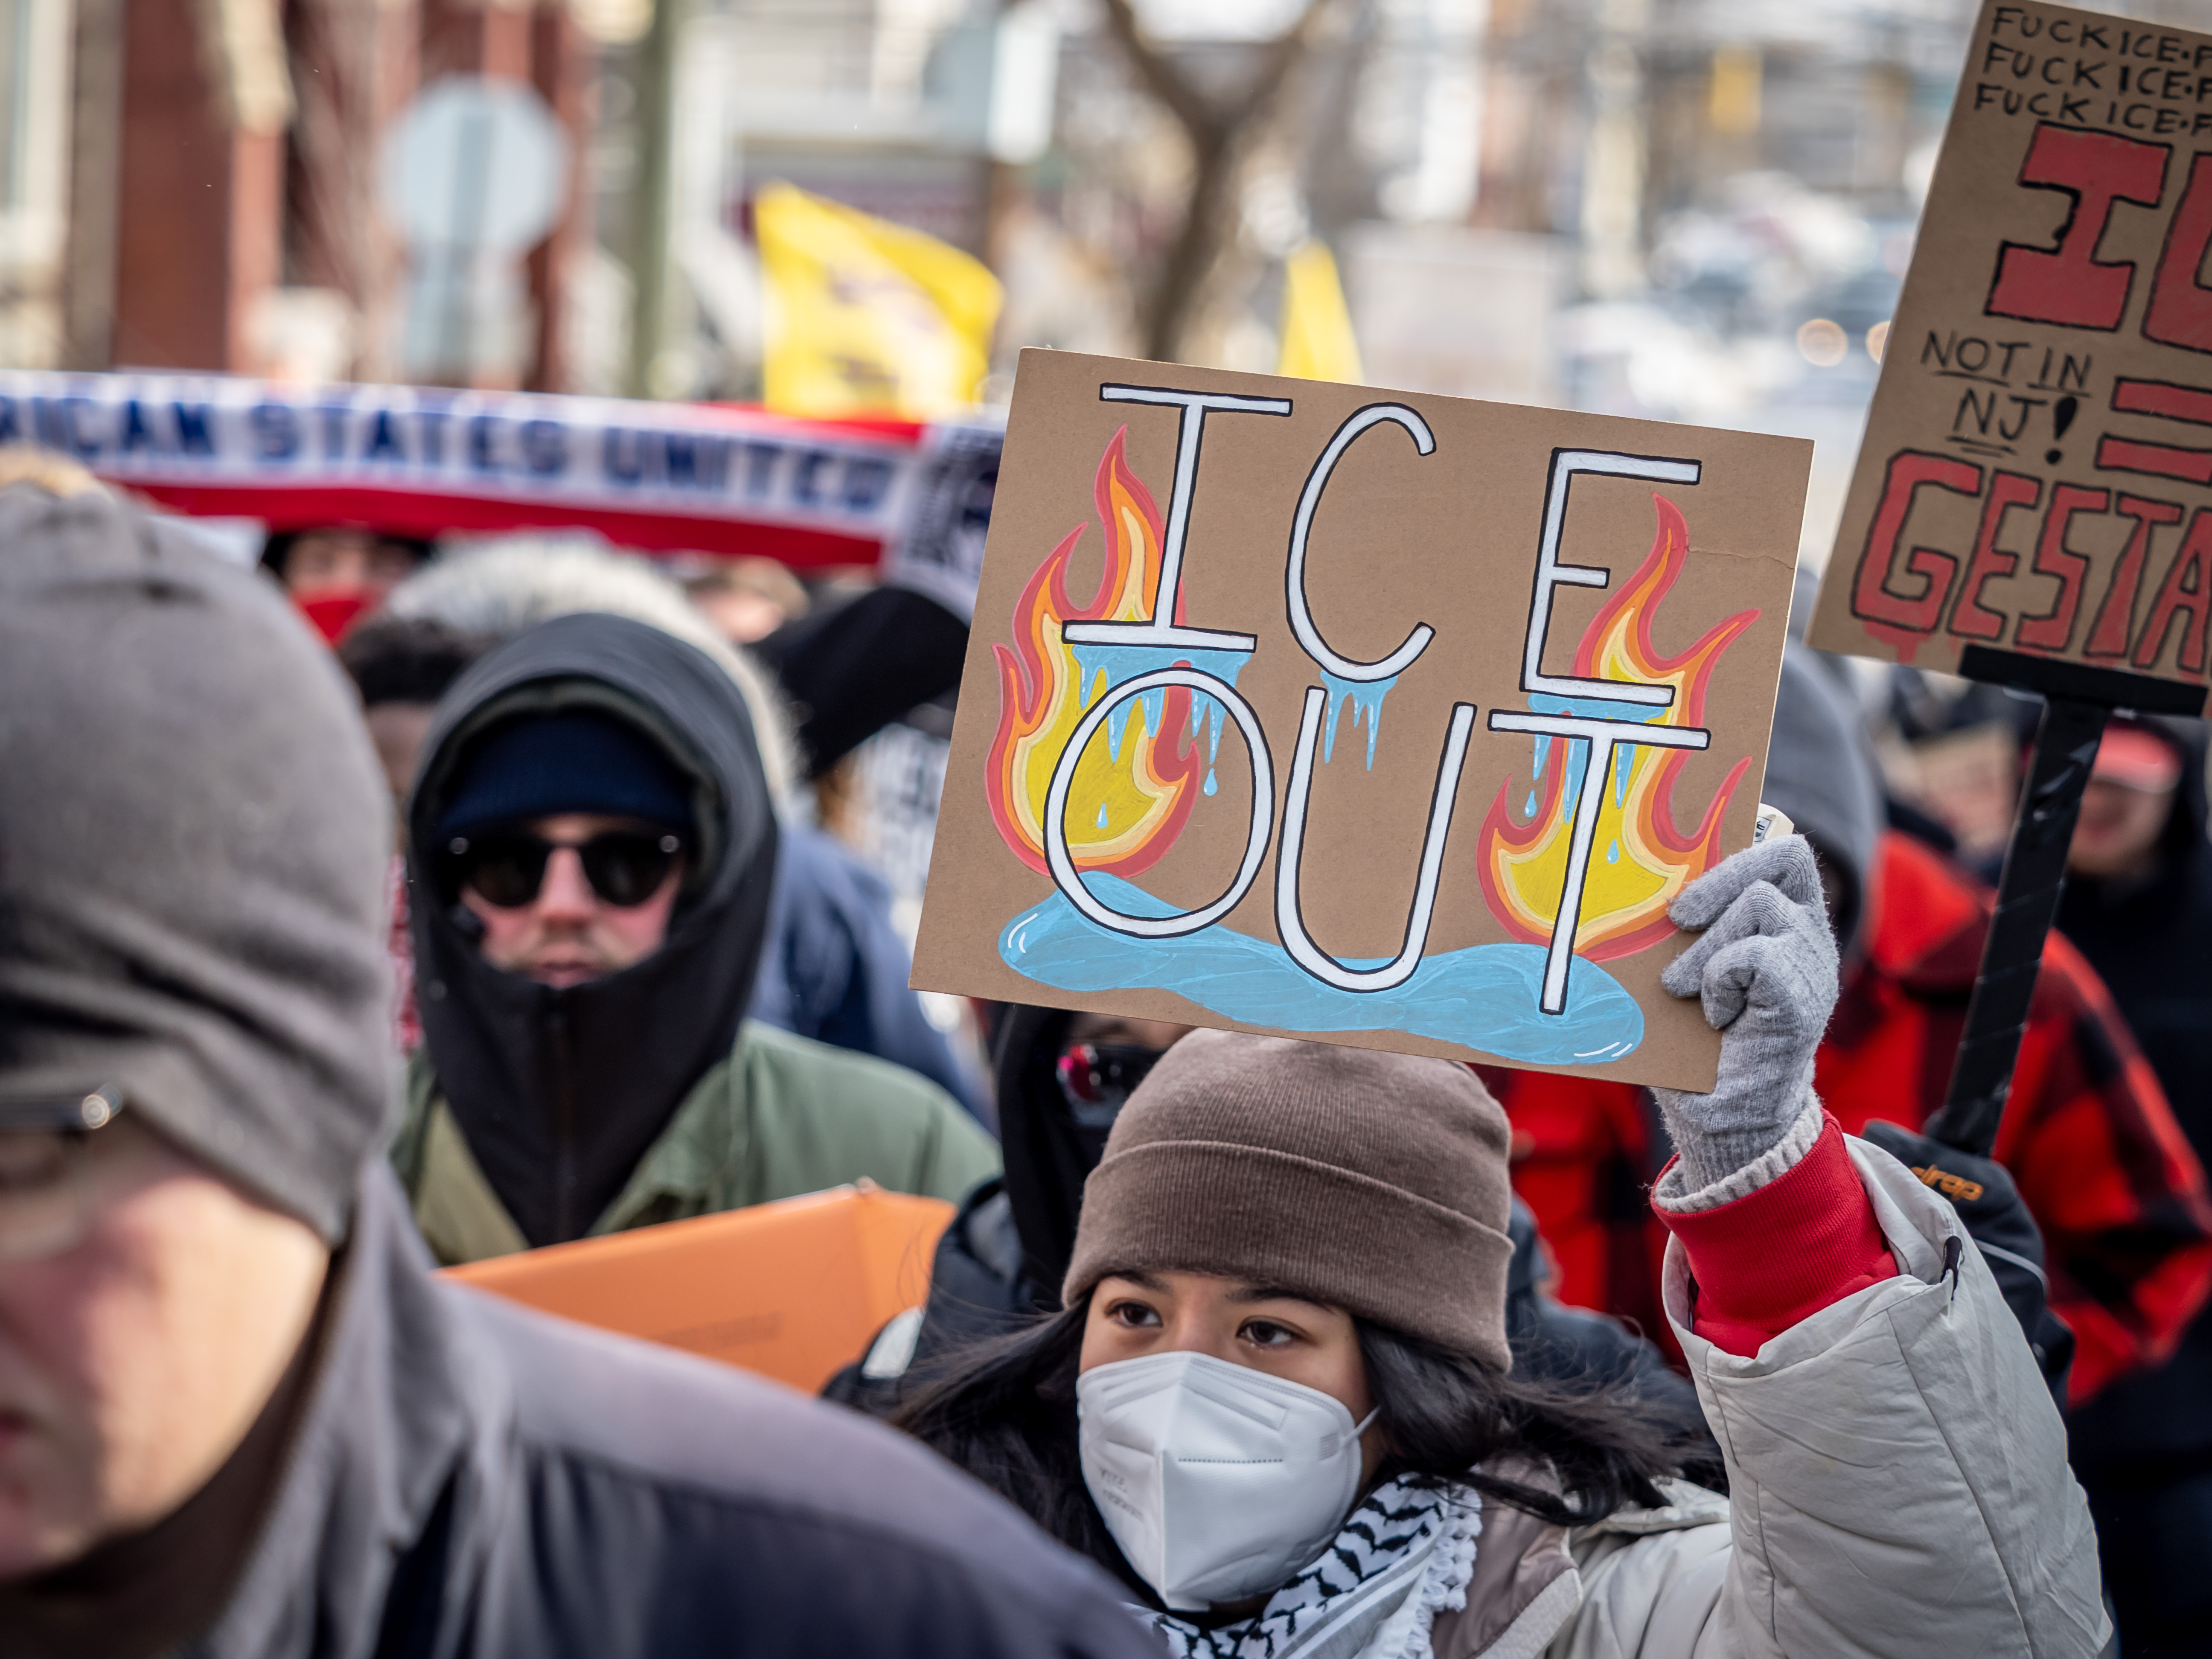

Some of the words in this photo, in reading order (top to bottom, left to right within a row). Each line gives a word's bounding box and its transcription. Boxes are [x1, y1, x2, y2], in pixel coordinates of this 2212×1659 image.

[1982, 41, 2107, 90] FUCK
[1991, 7, 2110, 49] FUCK
[1973, 83, 2091, 124] FUCK
[1920, 330, 2032, 379] NOT
[2037, 348, 2093, 390] IN
[0, 394, 215, 460] ICAN
[250, 402, 570, 480] STATES
[602, 425, 892, 510] UNITED
[1952, 386, 2079, 465] NJ!
[1061, 382, 1702, 705] ICE
[1851, 448, 2212, 674] GESTA
[1044, 667, 1711, 1016] OUT
